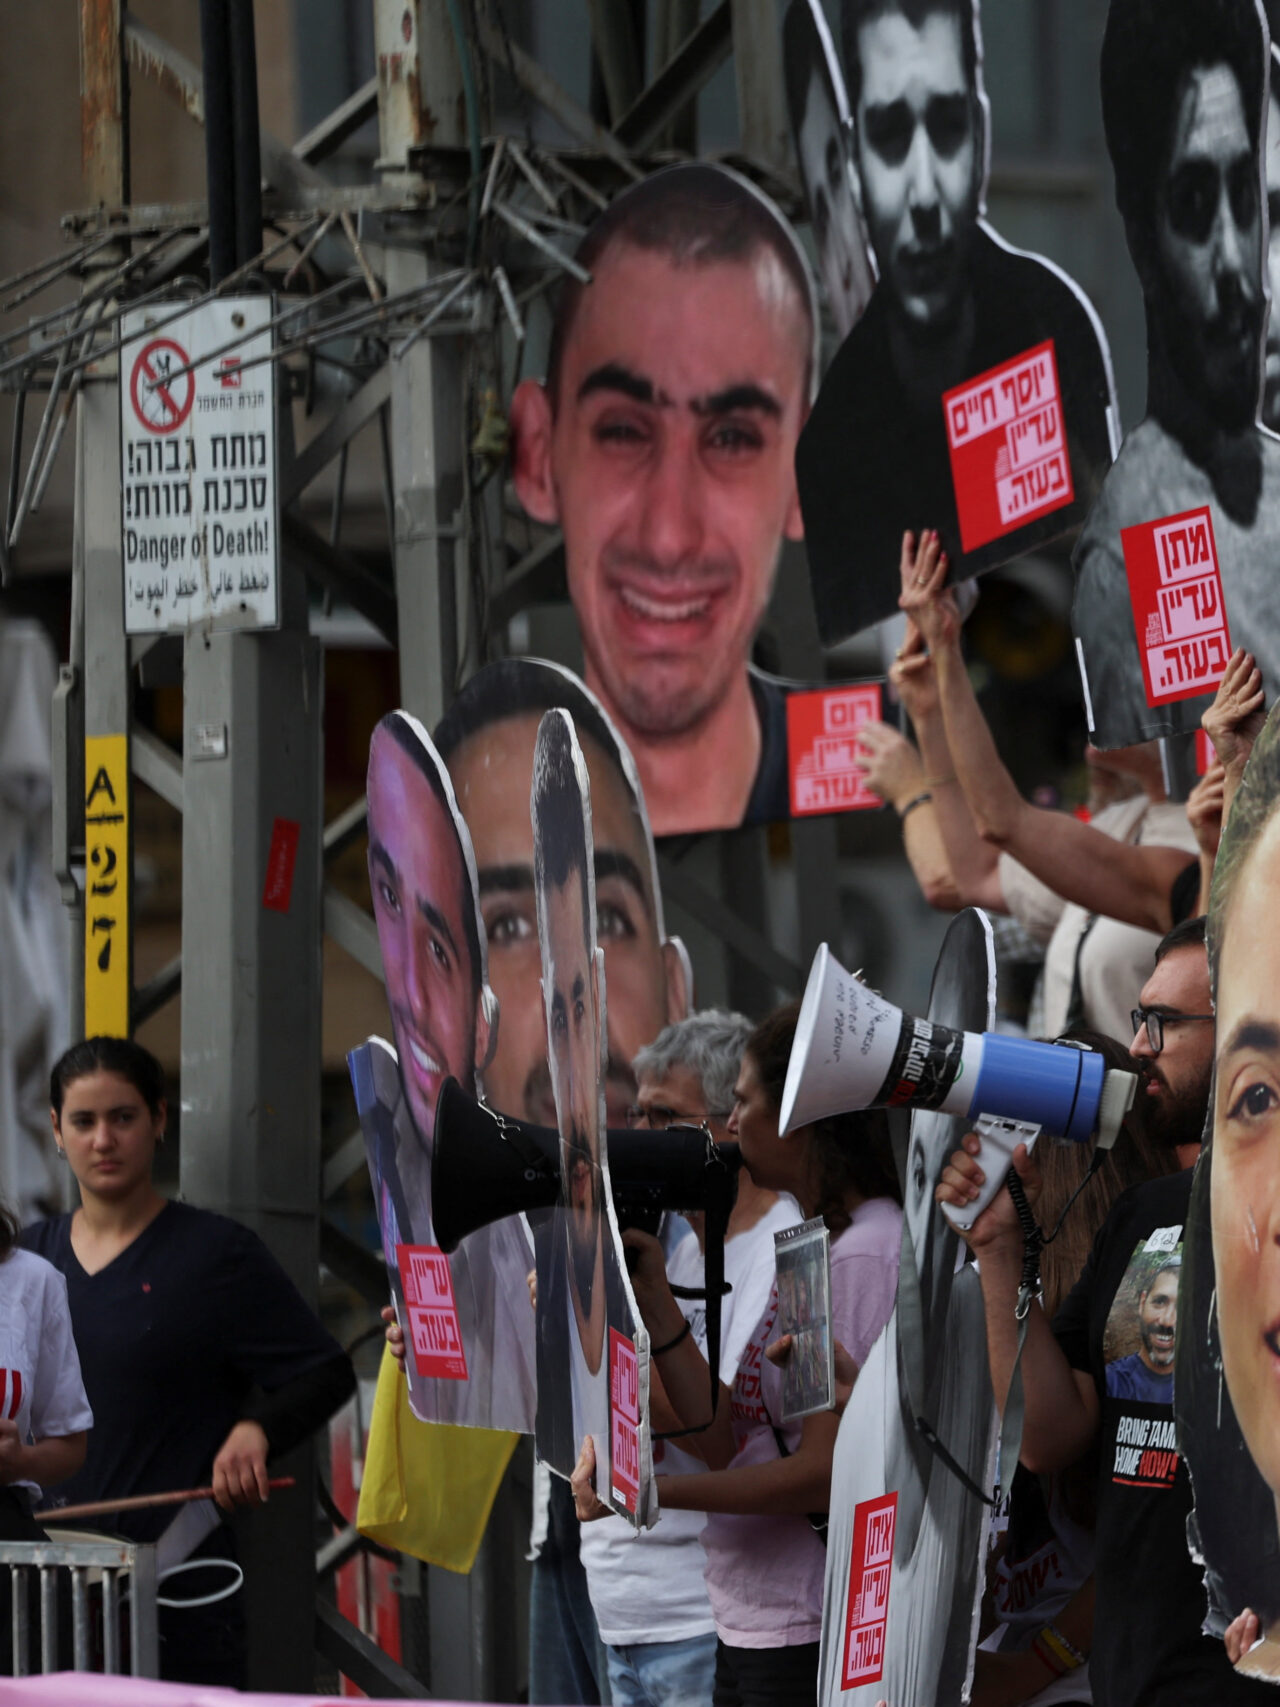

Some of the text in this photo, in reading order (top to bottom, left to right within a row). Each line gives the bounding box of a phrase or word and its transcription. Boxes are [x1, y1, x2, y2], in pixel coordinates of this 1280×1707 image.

[952, 360, 1045, 439] יוסף חיים
[127, 431, 267, 475] מתח גבוה!
[1010, 406, 1058, 465] עדיין
[125, 475, 267, 518] סכנת מוות!
[127, 529, 187, 568] Danger
[213, 517, 269, 557] Death!
[1160, 523, 1210, 579] מתן
[1161, 579, 1217, 635] עדיין
[1160, 636, 1227, 687] בעזה.
[412, 1259, 449, 1302] עדיין
[1116, 1416, 1151, 1447] BRING
[1113, 1445, 1179, 1482] HOME NOW!
[866, 1511, 893, 1564] איתן
[862, 1567, 888, 1619] עדיין
